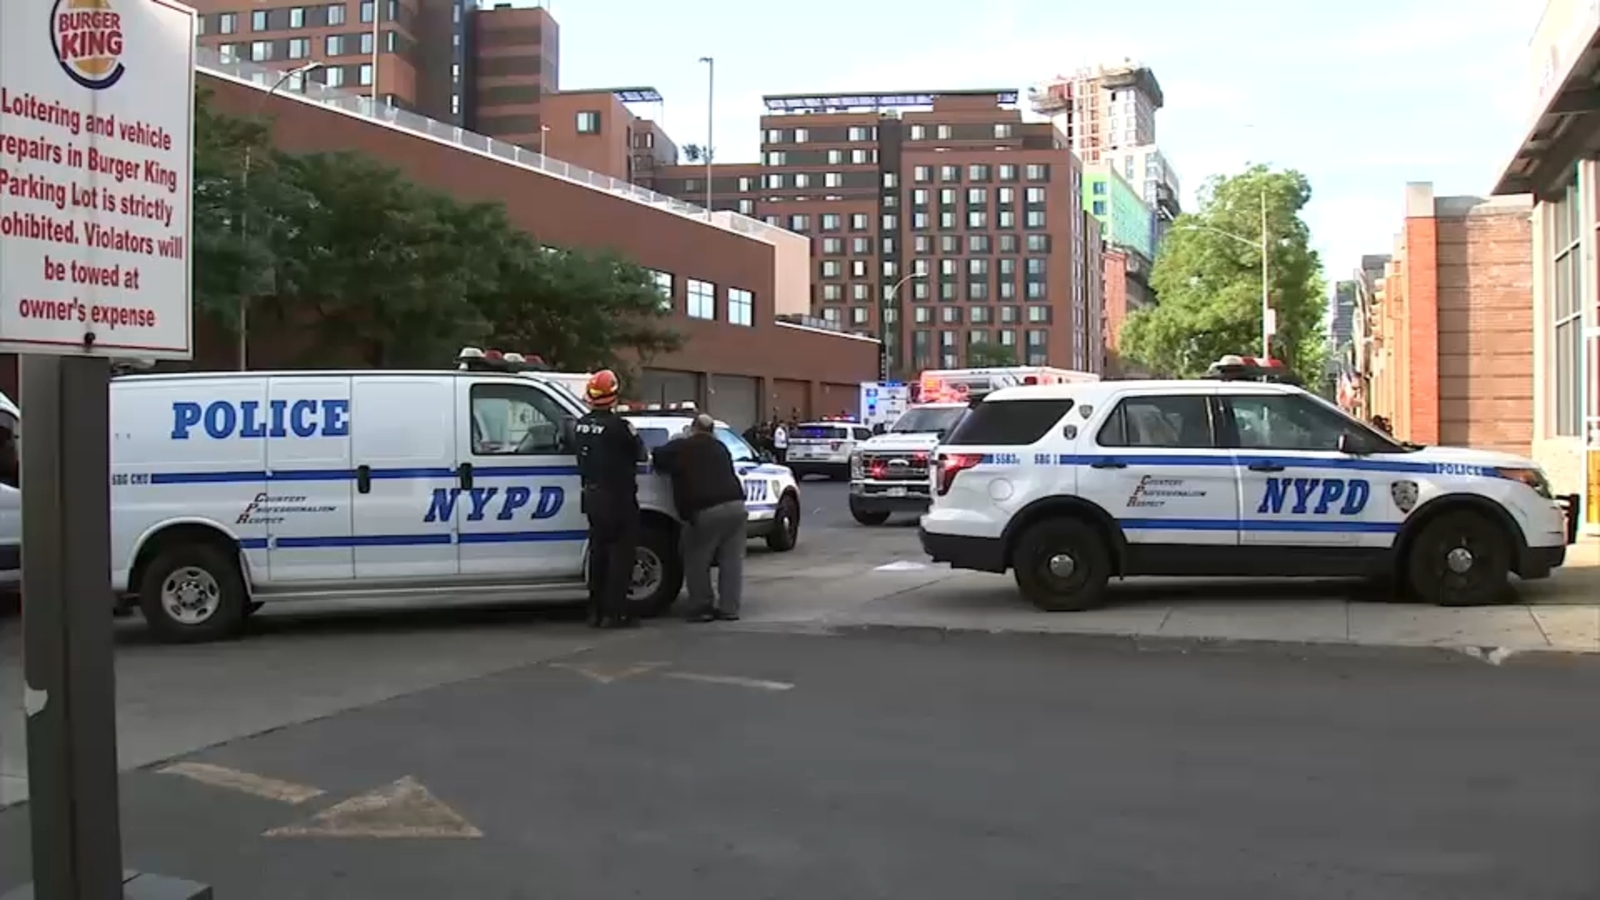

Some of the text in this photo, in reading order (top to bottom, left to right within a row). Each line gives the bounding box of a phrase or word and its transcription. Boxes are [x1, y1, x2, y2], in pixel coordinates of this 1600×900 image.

[59, 11, 121, 33] BURGER
[61, 30, 123, 60] KING
[2, 87, 171, 150] Loitering and vehicle
[0, 134, 176, 193] repairs in Burger King
[0, 168, 172, 227] Parking Lot is strictly
[0, 211, 182, 259] ohibited. Violators will
[44, 255, 139, 289] be towed at
[19, 297, 155, 330] owner's expense
[171, 400, 350, 439] POLICE
[1439, 463, 1482, 476] POLICE
[424, 486, 565, 522] NYPD
[1257, 478, 1370, 515] NYPD
